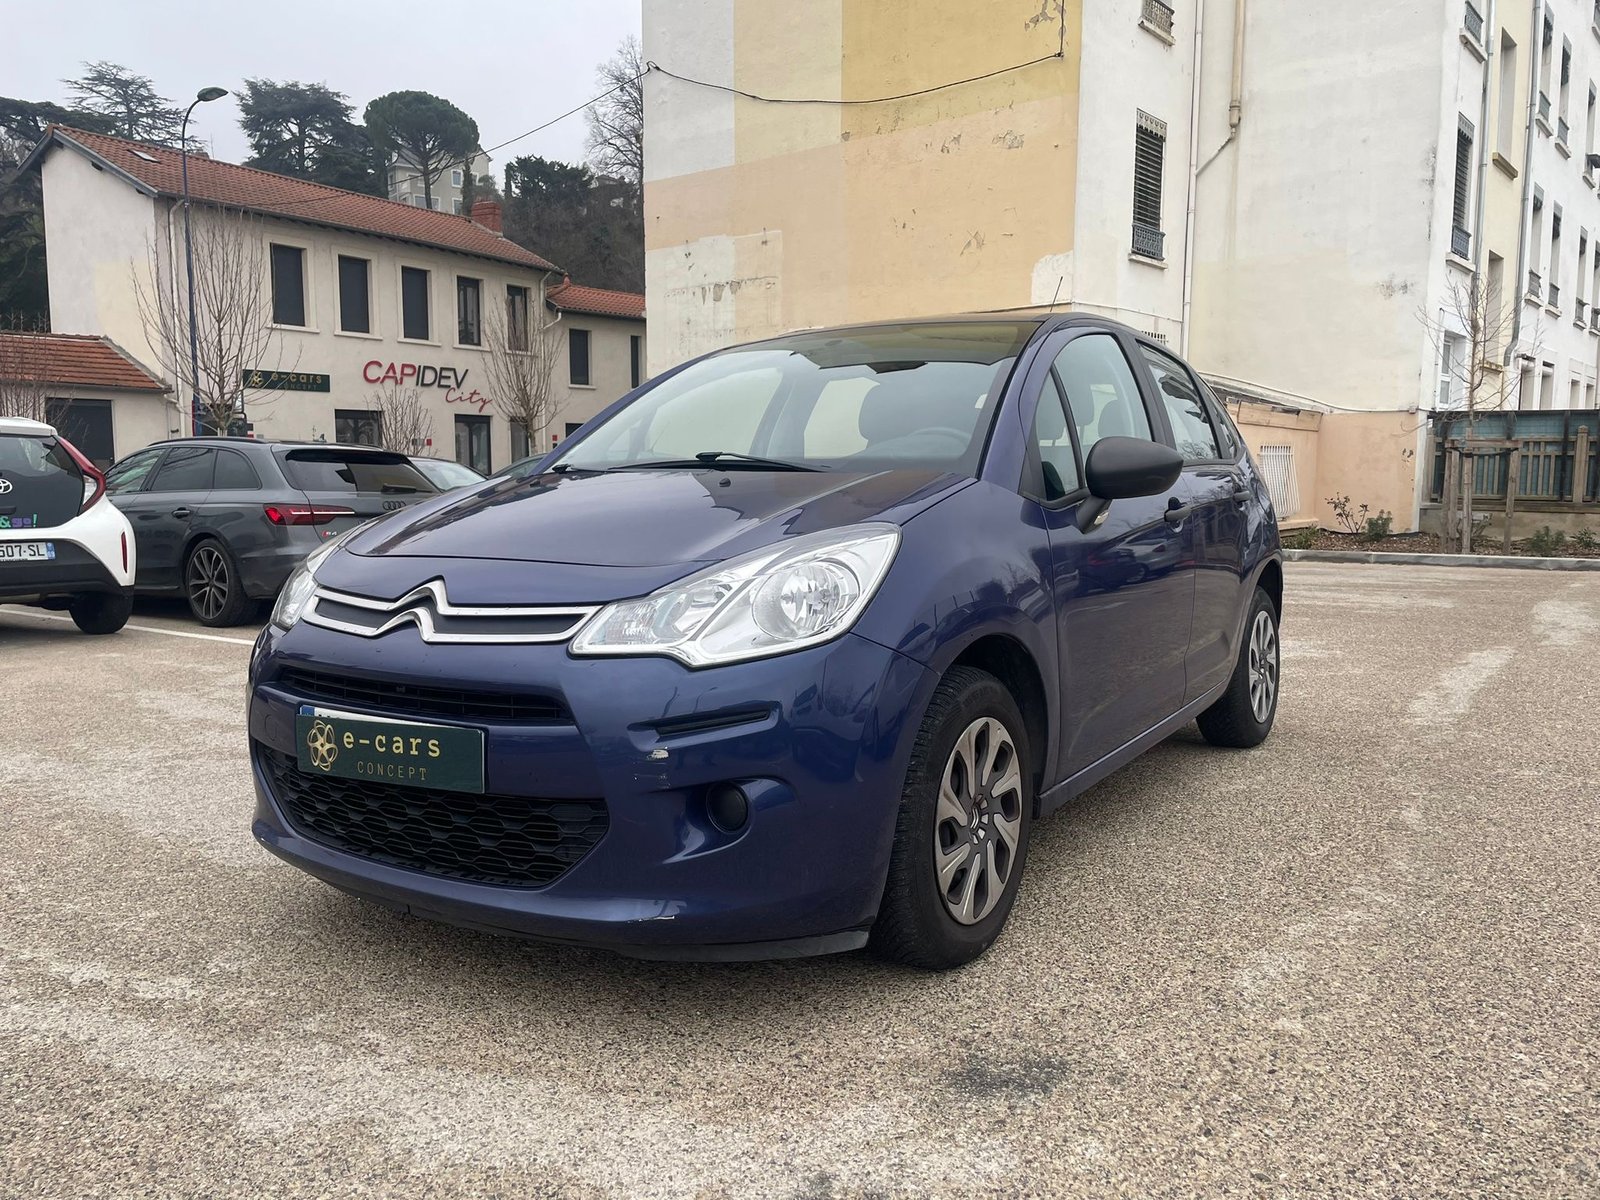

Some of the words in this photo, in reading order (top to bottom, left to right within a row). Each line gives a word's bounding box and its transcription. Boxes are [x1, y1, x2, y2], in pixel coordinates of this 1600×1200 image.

[271, 372, 322, 384] e-cars
[362, 360, 468, 389] CAPIDEV
[445, 387, 492, 412] City
[343, 732, 440, 757] e-cars
[357, 761, 427, 780] CONCEPT
